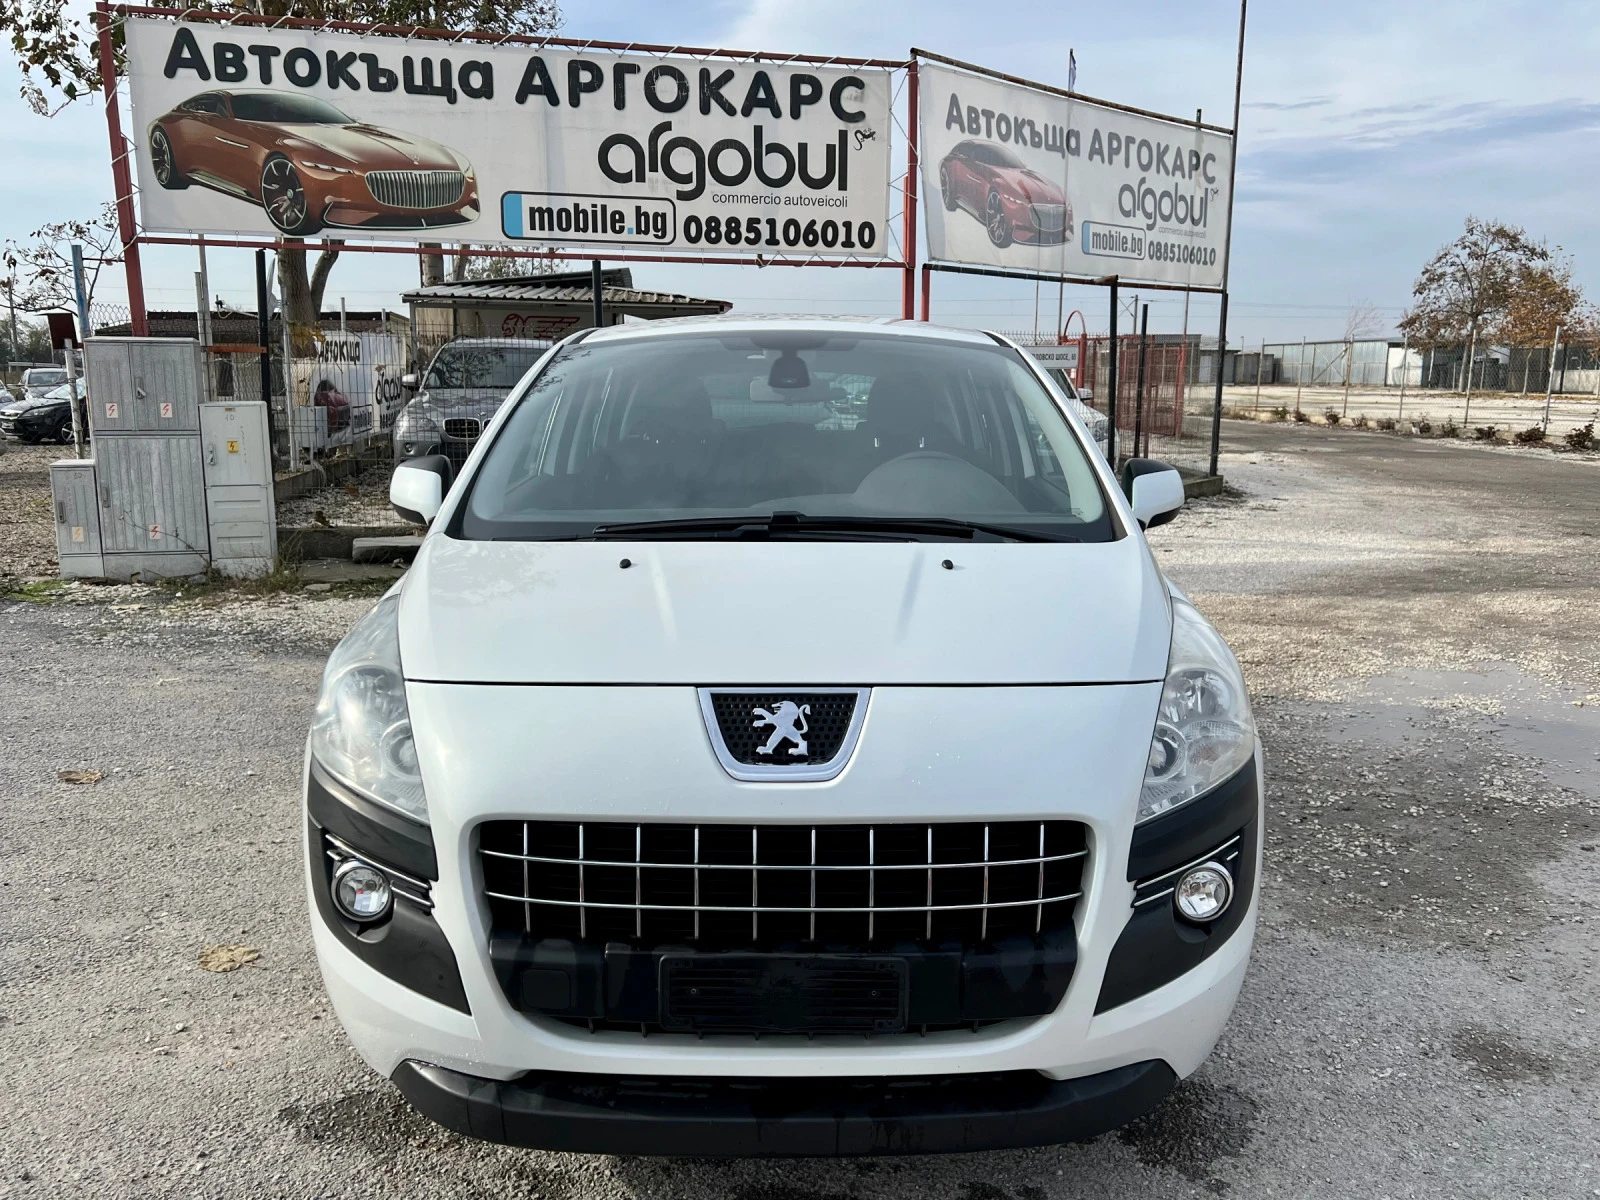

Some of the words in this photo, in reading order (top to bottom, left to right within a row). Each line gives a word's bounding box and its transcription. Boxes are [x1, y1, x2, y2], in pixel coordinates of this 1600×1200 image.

[163, 27, 494, 105] Автокъща
[515, 56, 866, 123] АРГОКАРС
[945, 92, 1081, 159] Автокъща
[1088, 128, 1217, 184] АРГОКАРС
[597, 120, 848, 201] argobul
[712, 193, 781, 206] commercio
[784, 195, 848, 208] autoveicoli
[1118, 176, 1209, 231] argobul
[529, 203, 667, 239] mobile.bg
[683, 214, 876, 249] 0885106010
[1092, 229, 1143, 257] mobile.bg
[1147, 240, 1216, 267] 0885106010
